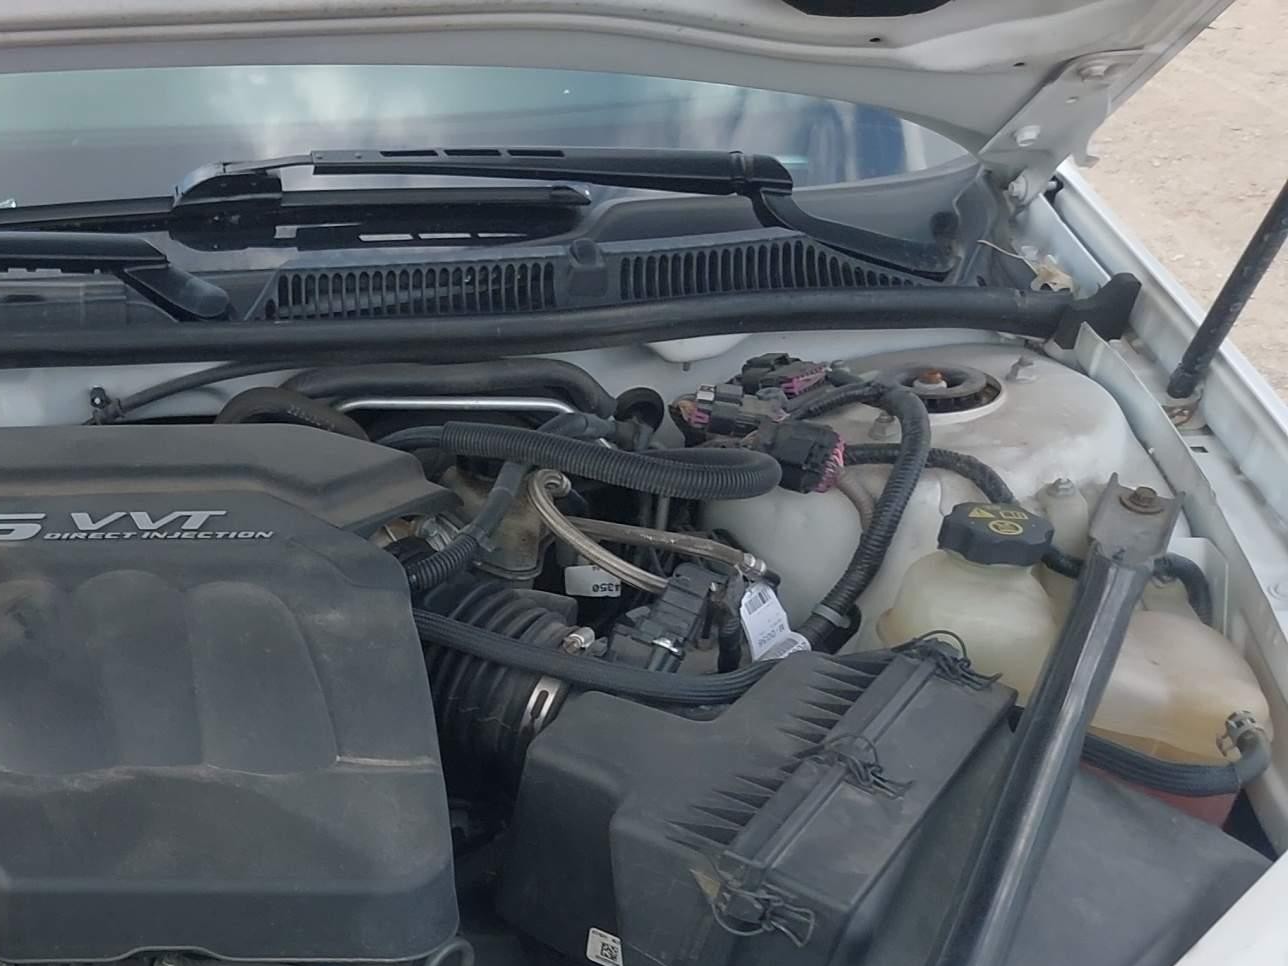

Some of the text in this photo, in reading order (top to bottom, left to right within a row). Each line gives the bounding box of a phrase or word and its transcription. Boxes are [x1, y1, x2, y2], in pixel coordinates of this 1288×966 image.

[70, 511, 228, 531] VVT
[43, 530, 276, 541] DIRECT INJECTION
